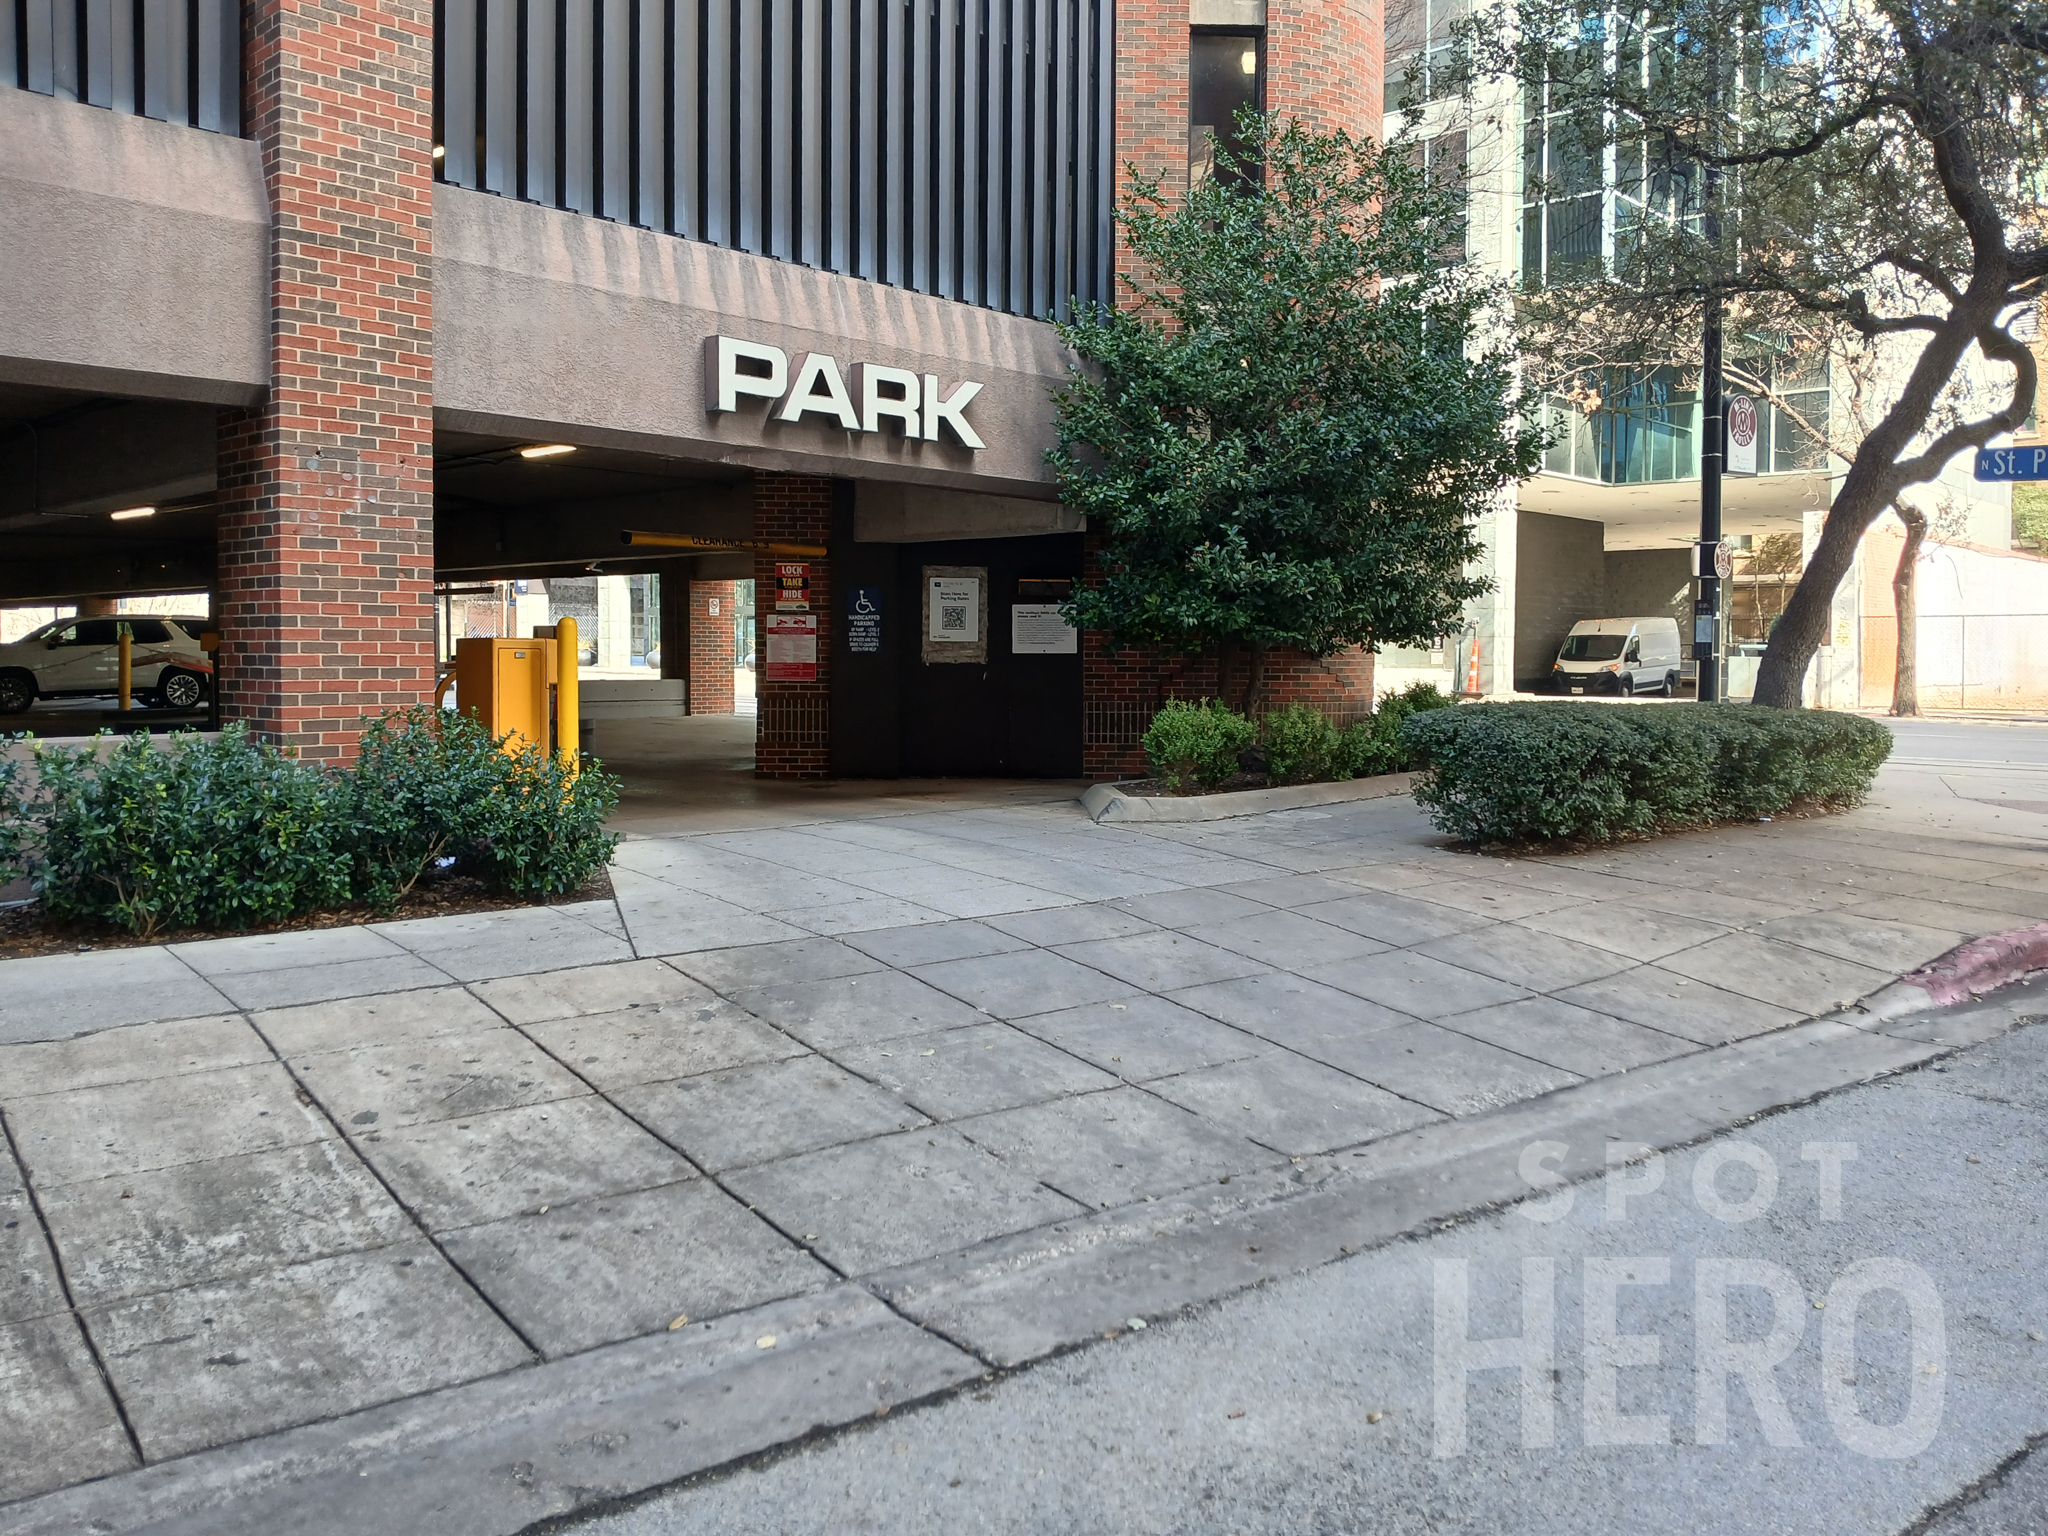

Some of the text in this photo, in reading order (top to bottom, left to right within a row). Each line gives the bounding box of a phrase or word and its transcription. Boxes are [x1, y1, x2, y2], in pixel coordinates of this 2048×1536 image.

[705, 335, 987, 449] PARK
[1981, 459, 1989, 471] N
[1993, 450, 2023, 475] St.
[782, 565, 803, 575] LOCK
[782, 577, 803, 587] TAKE
[783, 589, 803, 599] HIDE
